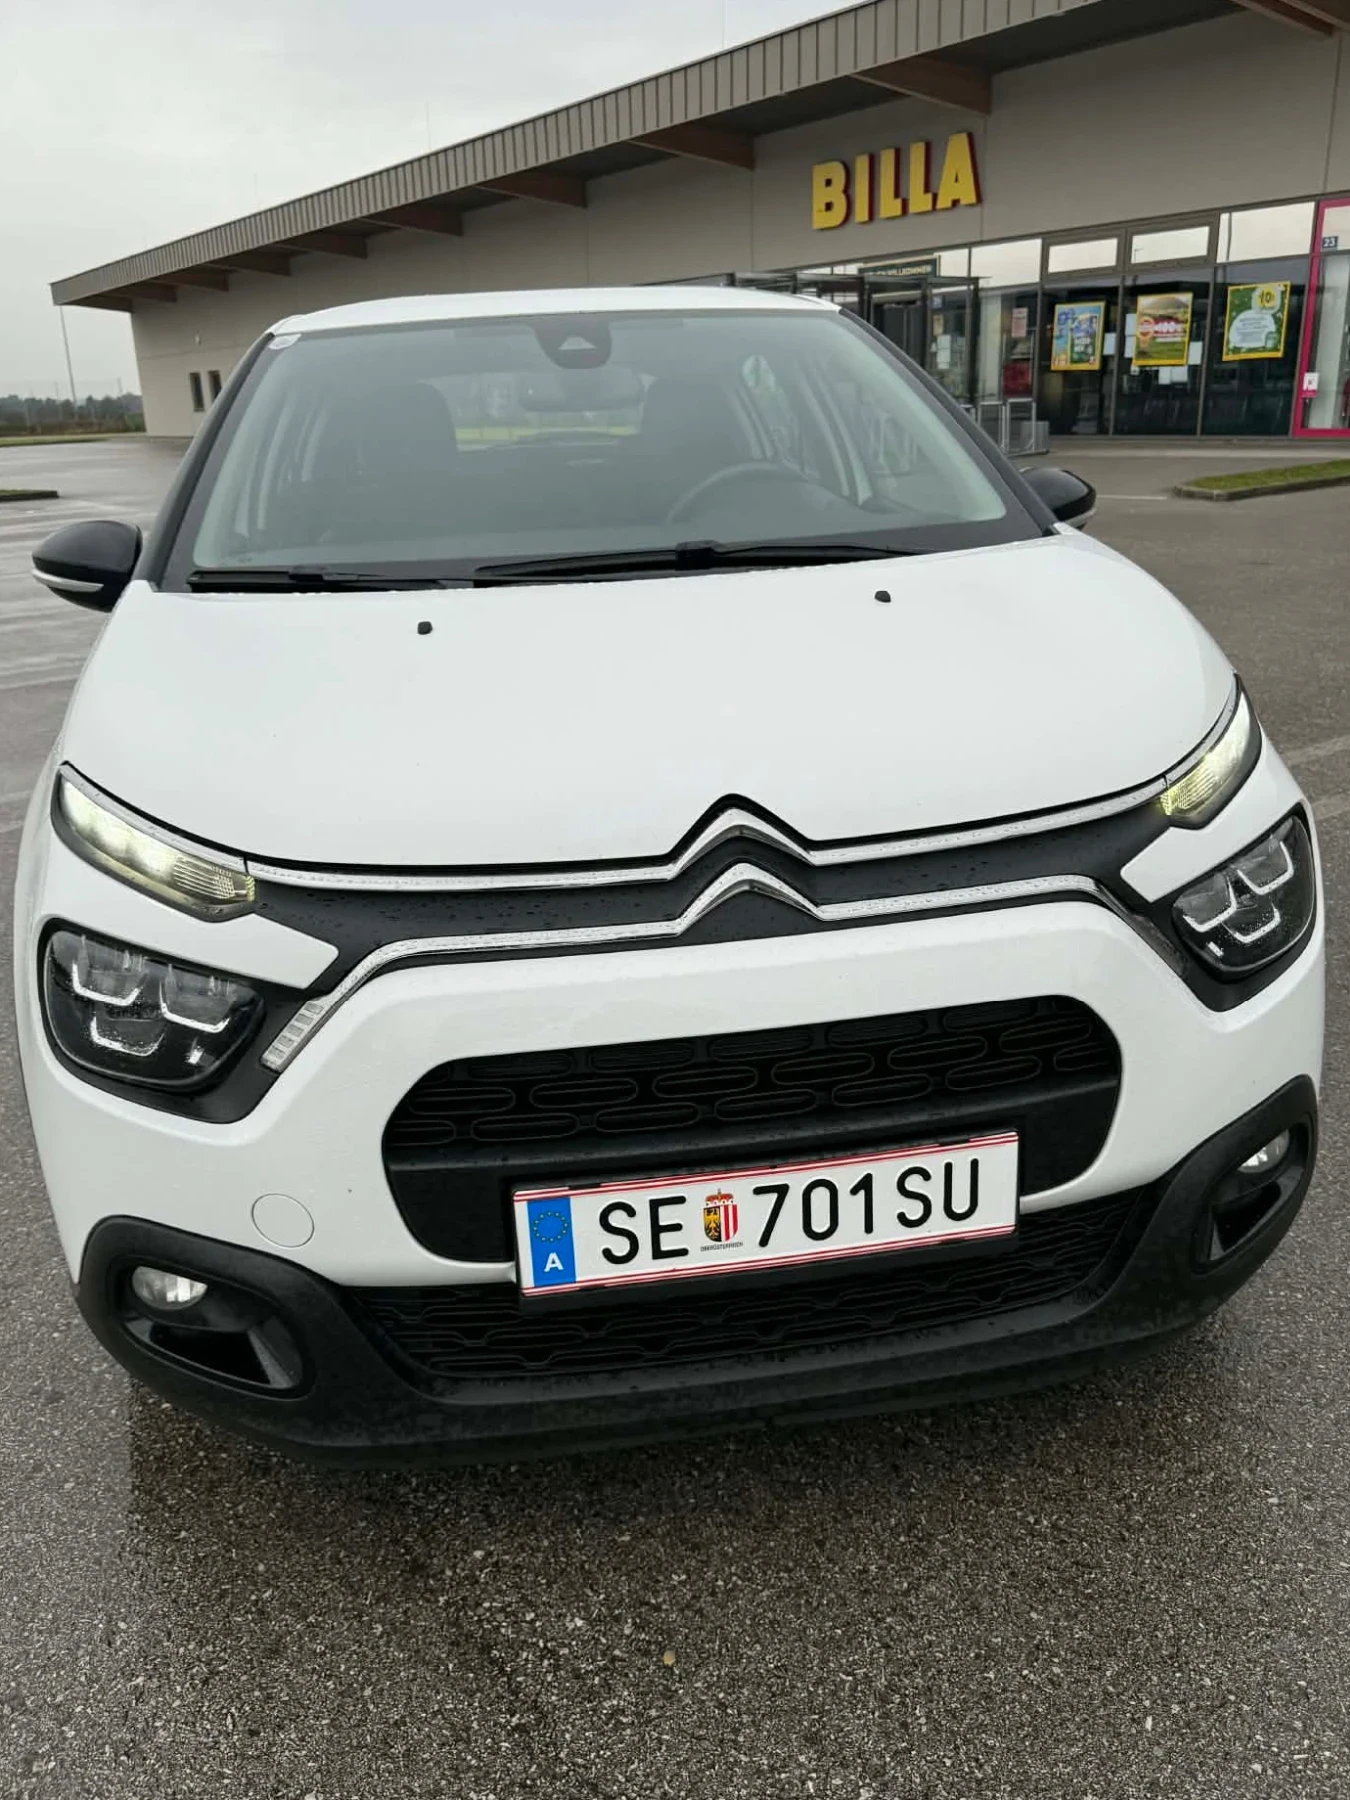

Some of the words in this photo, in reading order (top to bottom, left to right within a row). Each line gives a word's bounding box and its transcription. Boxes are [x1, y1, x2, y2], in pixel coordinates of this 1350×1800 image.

[812, 131, 982, 230] BILLA
[1323, 237, 1336, 248] 23
[599, 1195, 689, 1265] SE
[752, 1173, 874, 1248] 701
[896, 1158, 979, 1229] SU
[544, 1252, 564, 1273] A
